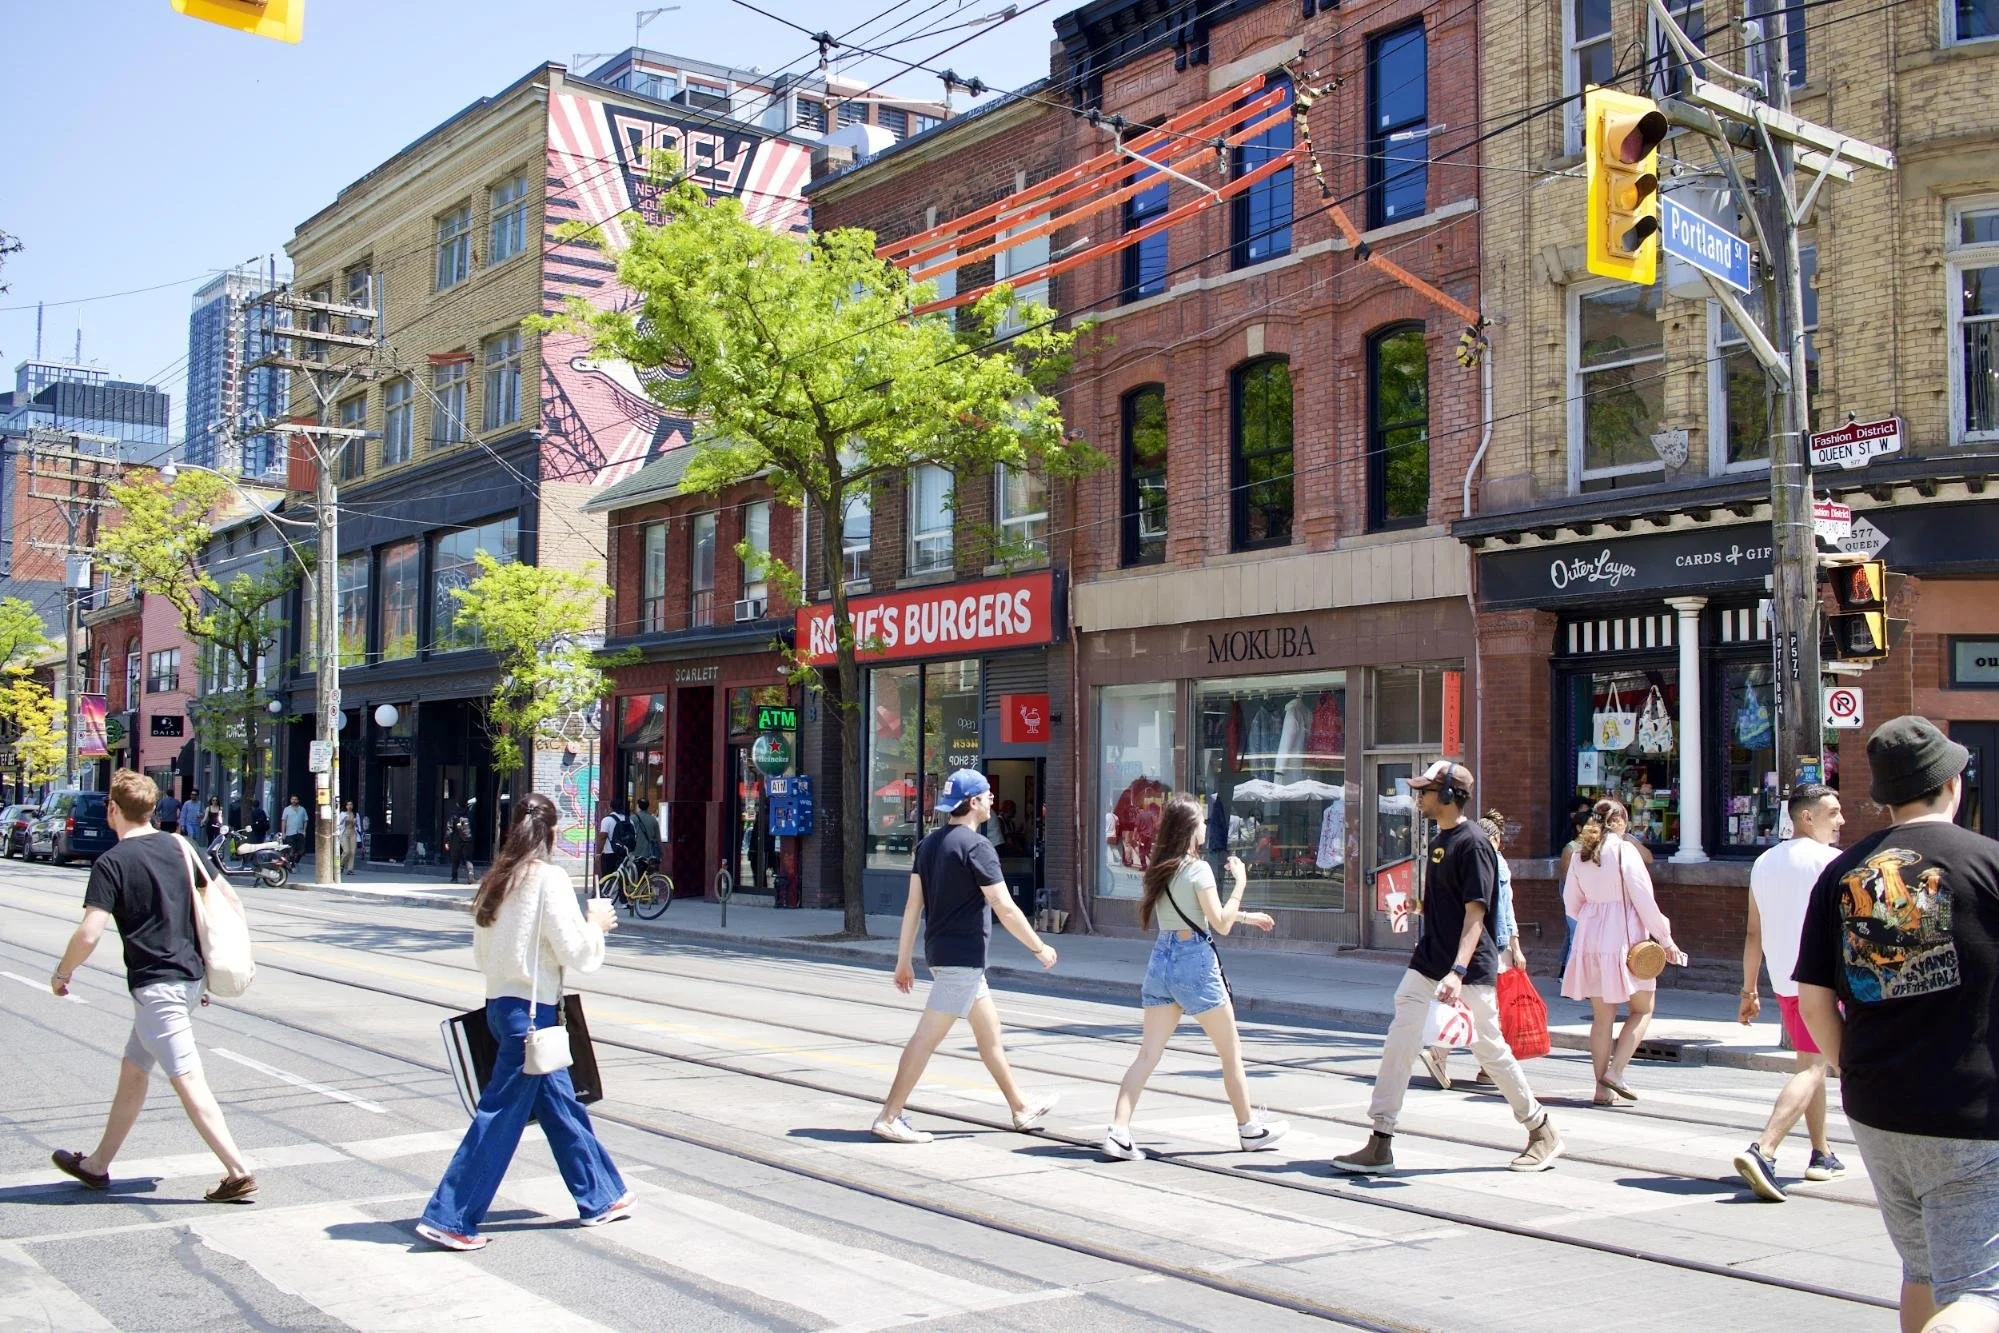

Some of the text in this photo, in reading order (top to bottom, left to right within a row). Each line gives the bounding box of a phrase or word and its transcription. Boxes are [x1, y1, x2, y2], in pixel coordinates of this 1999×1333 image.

[1671, 206, 1742, 269] Portland St
[1814, 424, 1895, 447] Fashion District
[1819, 444, 1853, 462] QUEEN
[1851, 528, 1874, 539] 577
[1845, 540, 1880, 551] QUEEN
[1675, 551, 1722, 567] CARDS
[809, 589, 1032, 656] ROIE'S BURGERS
[1207, 624, 1317, 664] MOKUBA
[675, 666, 719, 682] SCARLETT
[760, 711, 796, 728] ATM
[771, 782, 788, 794] ATM
[1911, 950, 1957, 976] VANS
